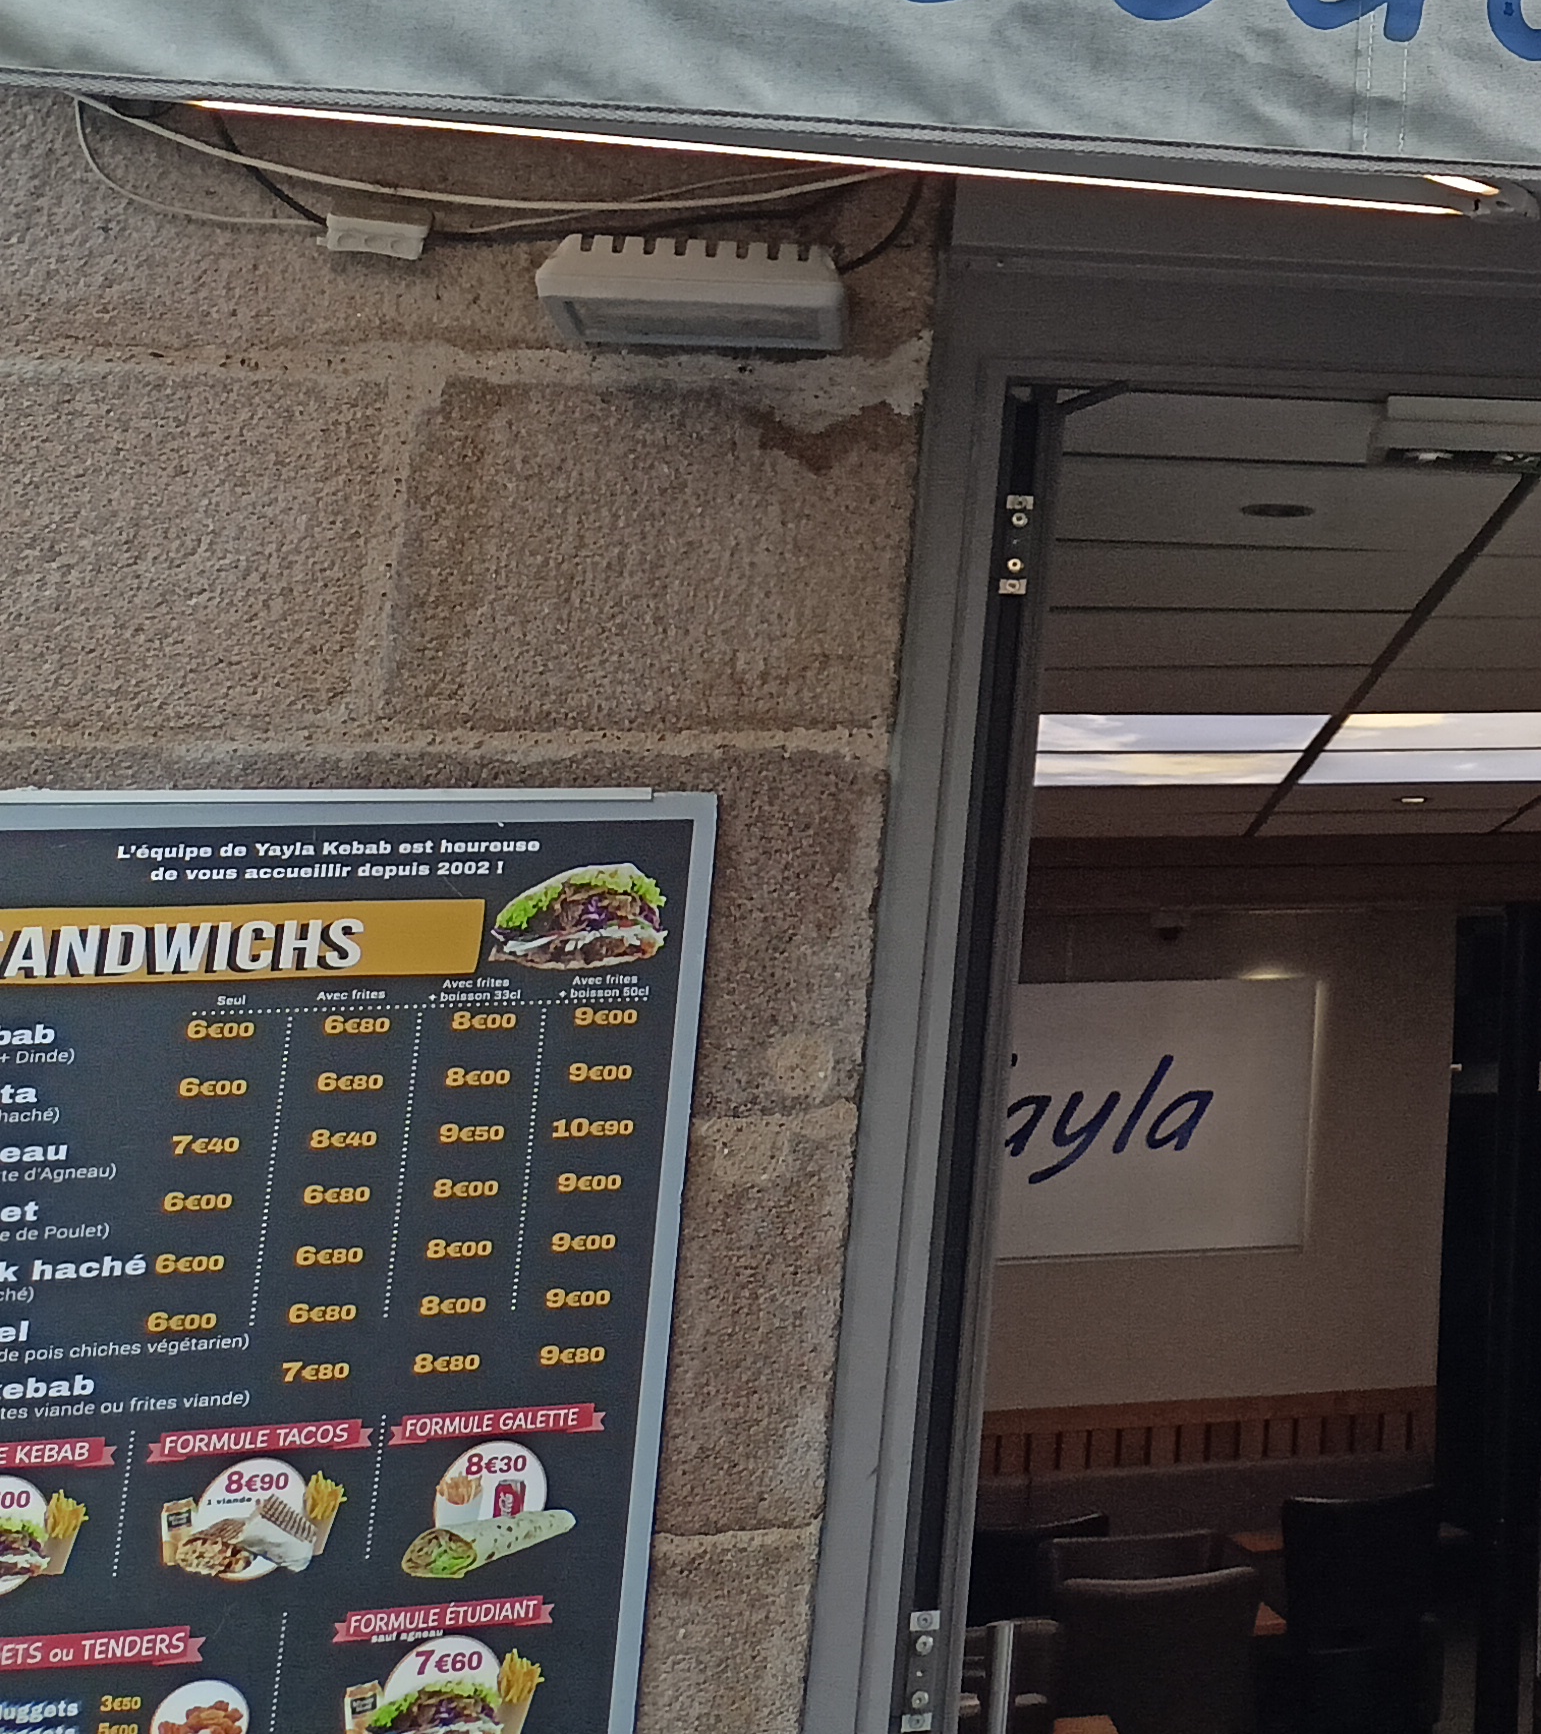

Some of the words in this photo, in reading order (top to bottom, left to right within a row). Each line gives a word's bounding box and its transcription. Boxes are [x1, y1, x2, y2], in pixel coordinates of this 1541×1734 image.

[220, 843, 247, 858] de
[255, 842, 315, 859] Yayla
[322, 839, 391, 855] Kebab
[399, 840, 434, 854] est
[440, 839, 540, 854] heureuse
[151, 866, 177, 881] de
[186, 867, 237, 880] vous
[358, 862, 430, 880] depuis
[437, 861, 490, 875] 2002
[0, 917, 365, 978] ANDWICHS
[442, 978, 473, 988] Avec
[477, 978, 509, 987] frites
[570, 987, 619, 998] boisson
[572, 976, 603, 985] Avec
[606, 974, 638, 984] frites
[217, 995, 246, 1006] Seul
[316, 990, 348, 1001] Avec
[352, 989, 386, 1000] frites
[440, 991, 490, 1001] boisson
[494, 990, 521, 1000] 33cl
[187, 1019, 255, 1039] 6€00
[323, 1015, 390, 1035] 6€80
[451, 1011, 517, 1030] 8€00
[574, 1007, 638, 1026] 9€00
[16, 1047, 75, 1064] Dinde)
[179, 1077, 247, 1098] 6€00
[316, 1072, 384, 1092] 6€80
[445, 1067, 511, 1087] 8€00
[568, 1062, 633, 1082] 9€00
[1005, 1054, 1214, 1184] ayla
[172, 1135, 240, 1155] 7€40
[309, 1129, 378, 1148] 8€40
[439, 1124, 505, 1144] 9€50
[552, 1118, 634, 1139] 10€90
[24, 1163, 116, 1183] d'Agneau)
[163, 1191, 233, 1212] 6€00
[303, 1185, 371, 1205] 6€80
[433, 1179, 499, 1199] 8€00
[557, 1173, 622, 1193] 9€00
[15, 1227, 39, 1241] de
[44, 1223, 110, 1240] Poulet)
[31, 1253, 147, 1281] haché
[155, 1254, 225, 1275] 6€00
[295, 1246, 364, 1266] 6€80
[426, 1239, 493, 1259] 8€00
[551, 1232, 616, 1253] 9€00
[147, 1312, 217, 1333] 6€00
[288, 1303, 357, 1324] 6€80
[419, 1295, 487, 1316] 8€00
[545, 1288, 611, 1309] 9€00
[24, 1345, 64, 1363] pois
[69, 1341, 141, 1358] chiches
[147, 1333, 250, 1355] végétarien)
[282, 1361, 350, 1383] 7€80
[413, 1353, 480, 1374] 8€80
[539, 1345, 606, 1366] 9€80
[34, 1401, 96, 1419] viande
[100, 1398, 124, 1414] ou
[129, 1394, 177, 1412] frites
[183, 1390, 250, 1409] viande)
[405, 1415, 493, 1437] FORMULE
[499, 1408, 580, 1429] GALETTE
[163, 1430, 270, 1455] FORMULE
[277, 1423, 349, 1446] TACOS
[14, 1442, 90, 1464] KEBAB
[465, 1453, 527, 1476] 8€30
[224, 1470, 290, 1494] 8€90
[349, 1607, 439, 1635] FORMULE
[445, 1600, 538, 1626] ÉTUDIANT
[49, 1648, 74, 1662] ou
[81, 1632, 187, 1661] TENDERS
[371, 1632, 398, 1643] sauf
[400, 1629, 444, 1643] agneau
[415, 1649, 483, 1676] 7€60
[100, 1695, 141, 1712] 3€50
